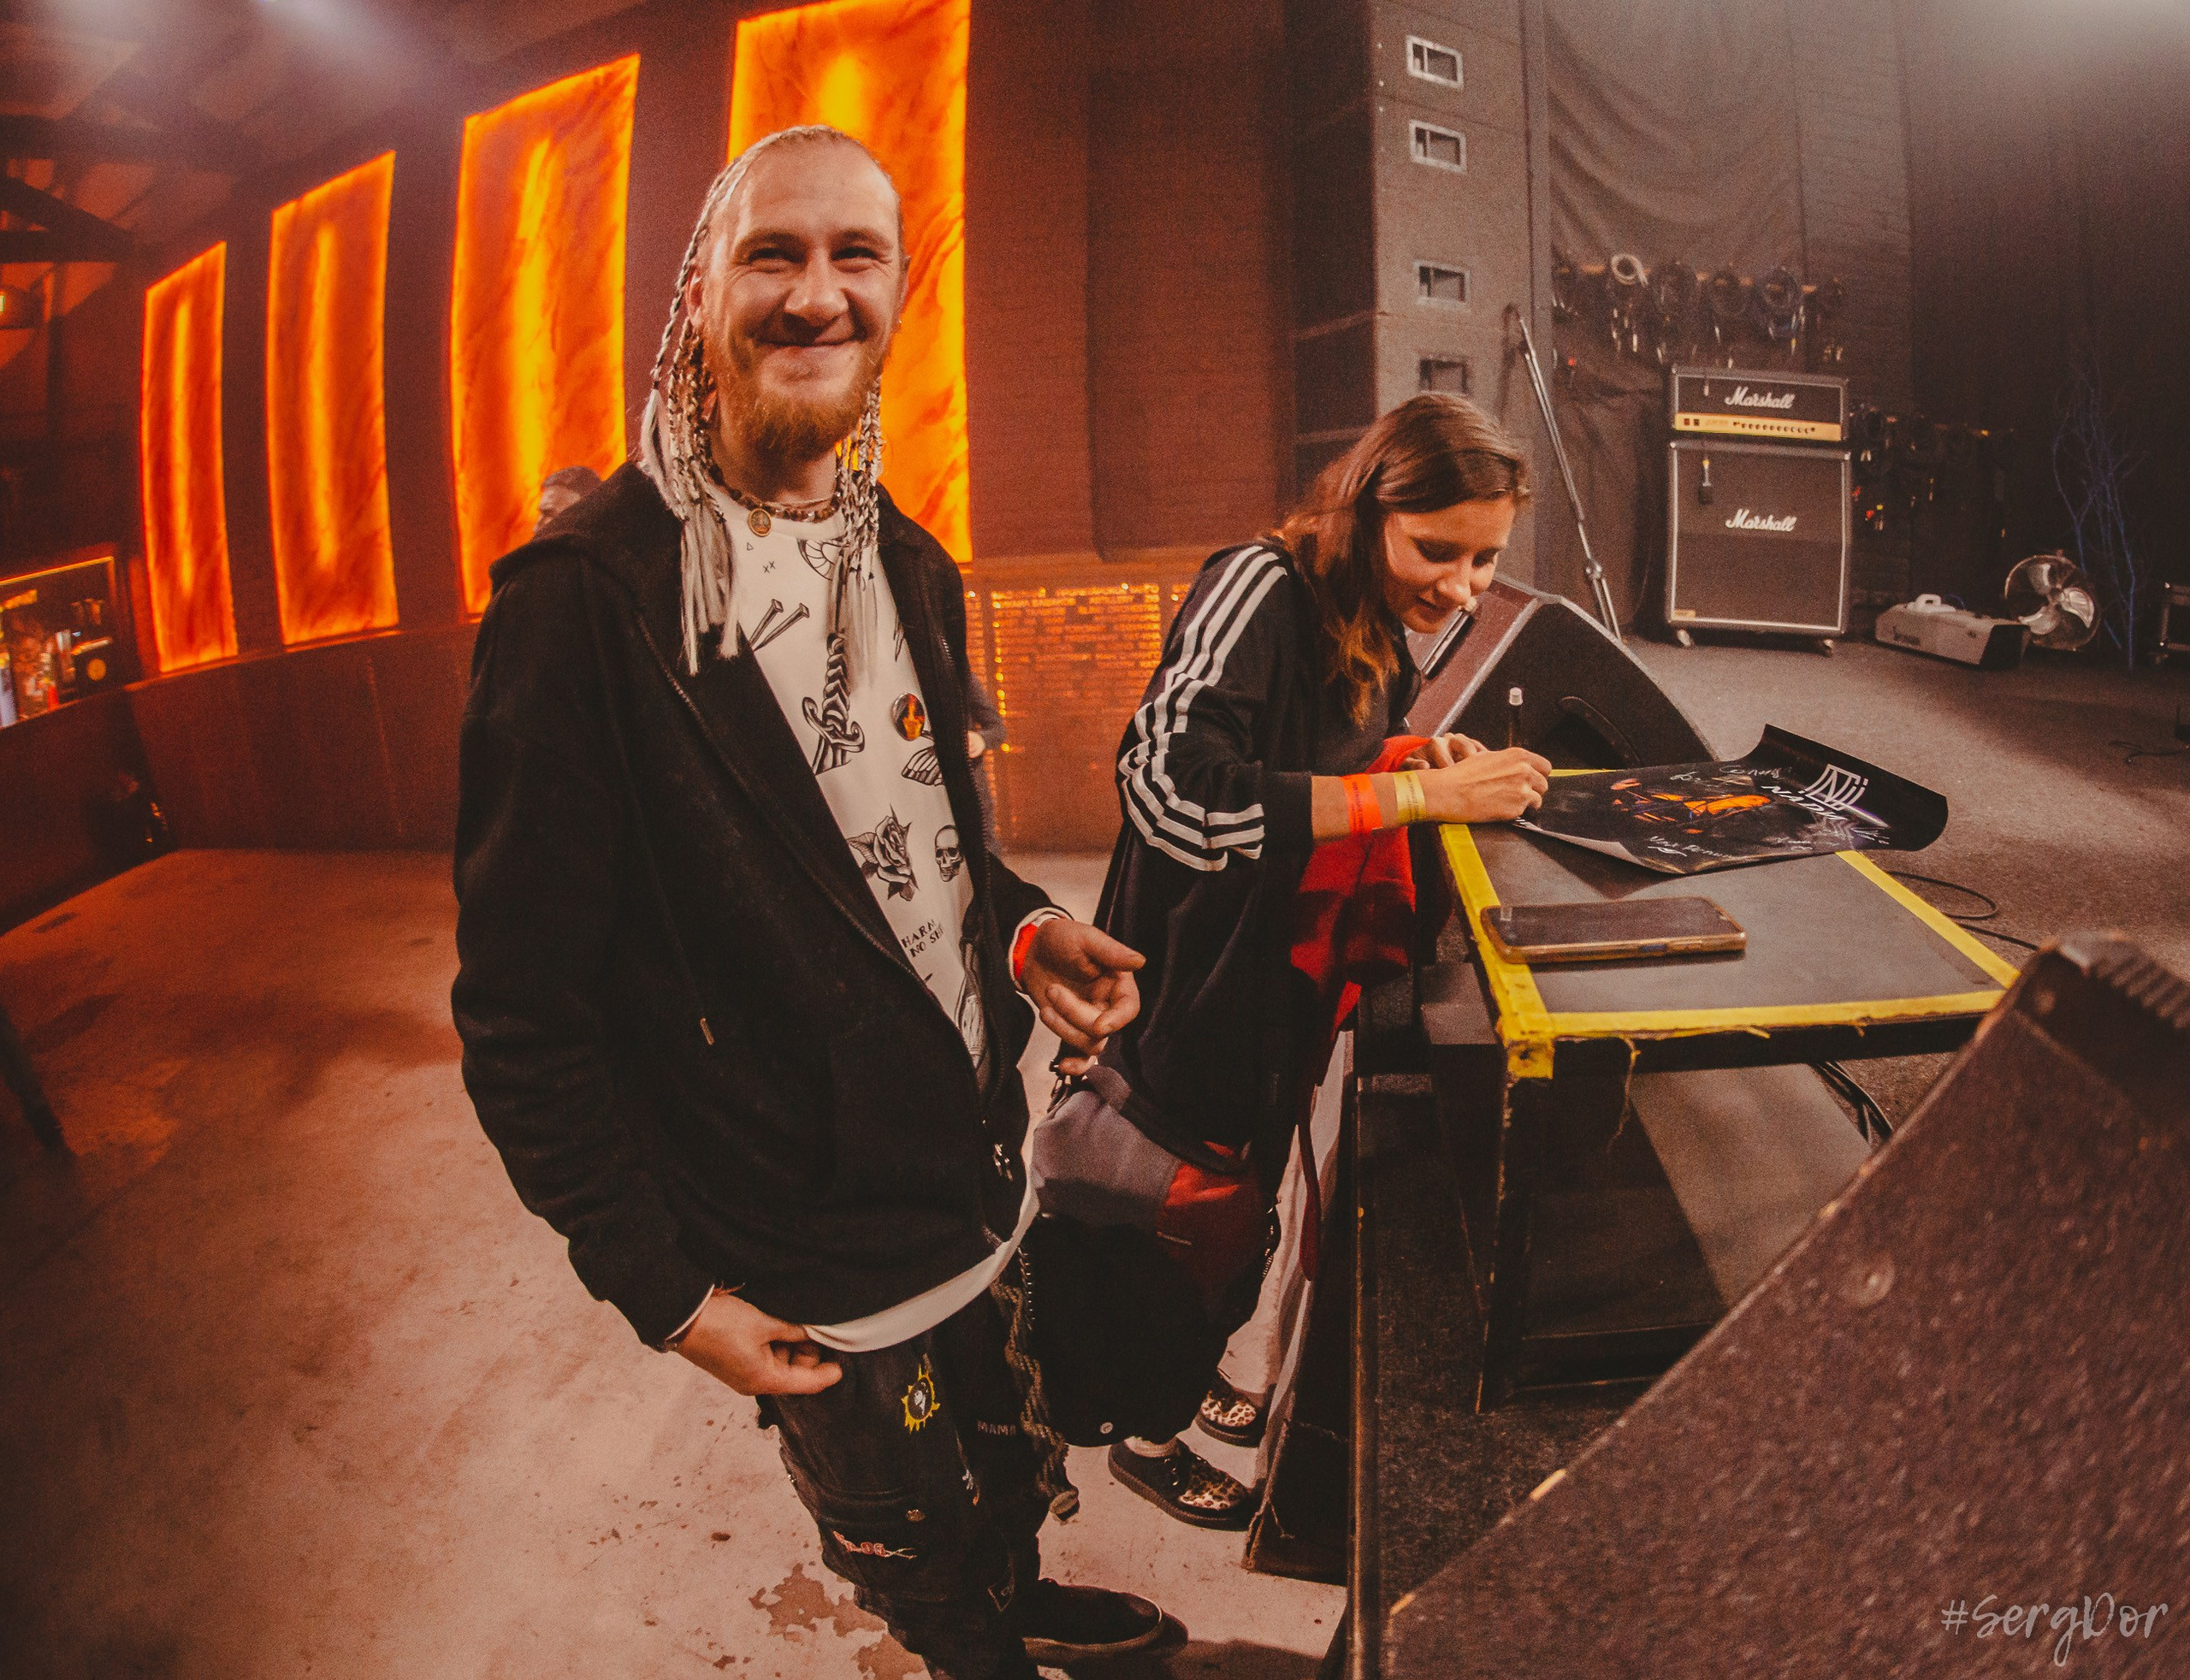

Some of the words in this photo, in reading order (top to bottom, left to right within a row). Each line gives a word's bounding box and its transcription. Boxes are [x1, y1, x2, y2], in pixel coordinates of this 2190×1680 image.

[1725, 387, 1796, 409] Marshall
[1725, 509, 1797, 532] Marshall
[909, 941, 926, 957] NO
